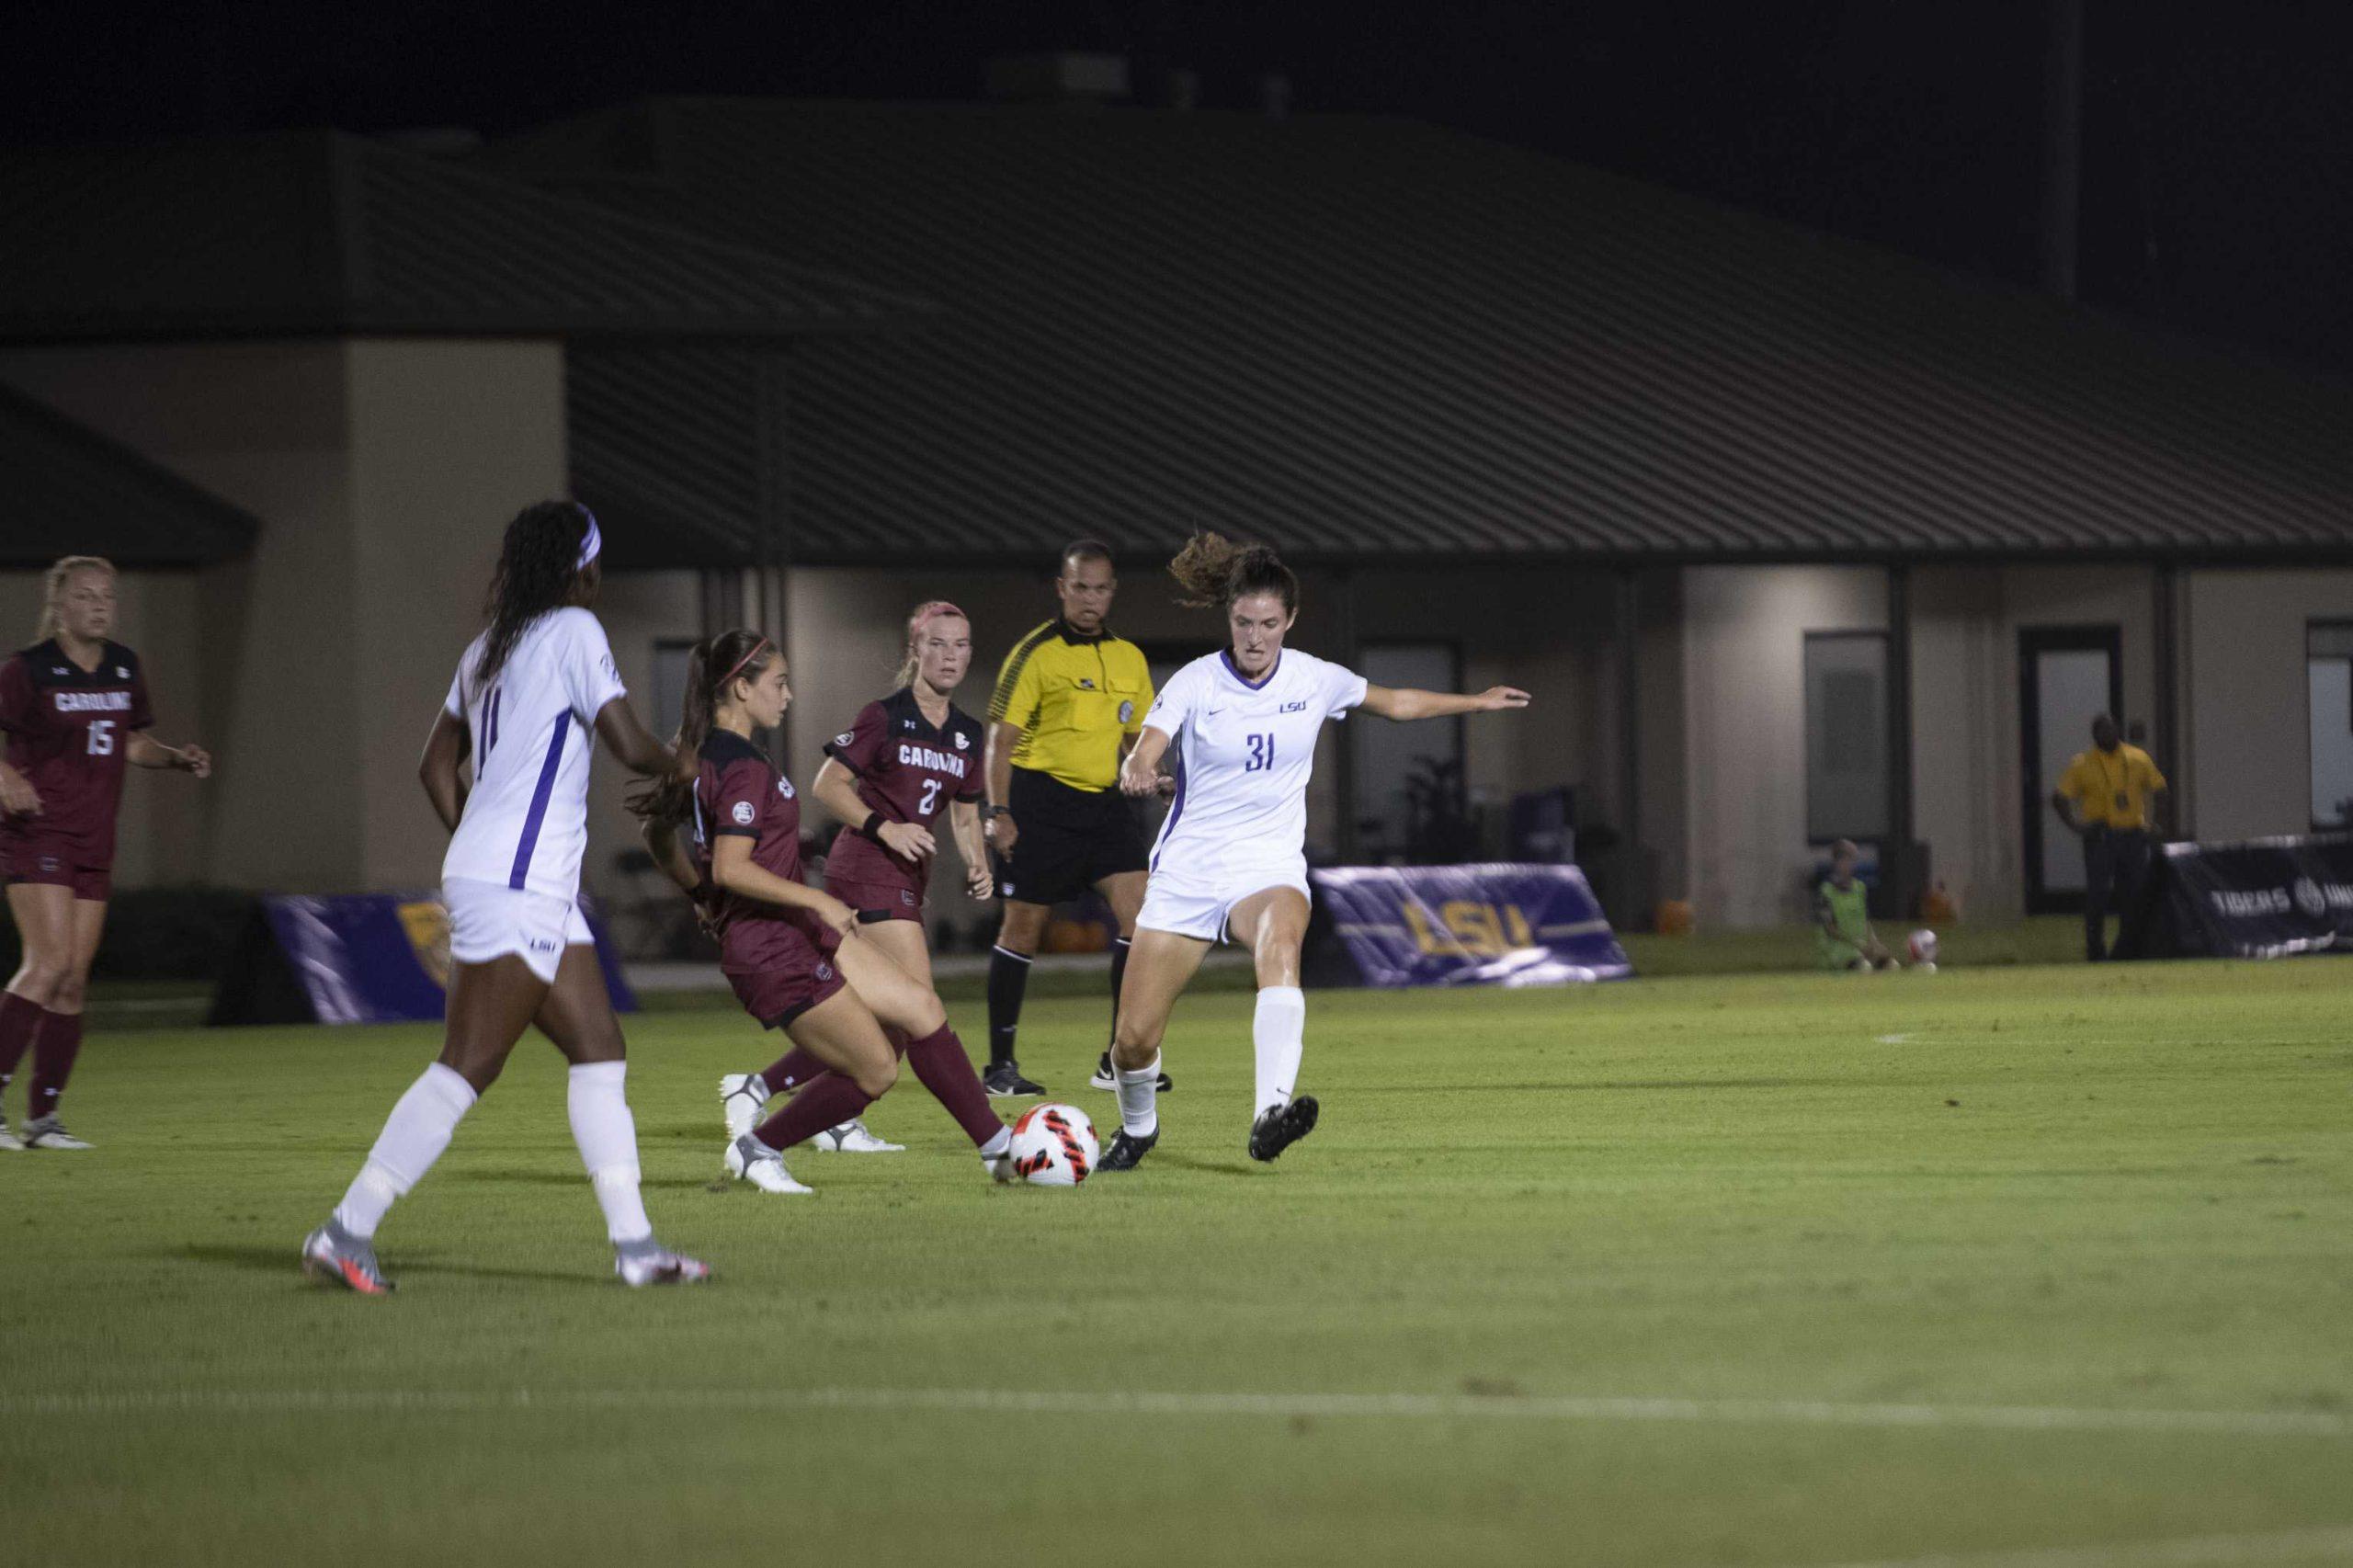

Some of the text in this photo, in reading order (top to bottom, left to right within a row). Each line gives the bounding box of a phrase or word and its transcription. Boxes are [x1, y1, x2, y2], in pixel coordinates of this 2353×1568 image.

[1279, 700, 1306, 713] LSU
[86, 721, 116, 756] 15
[1245, 733, 1274, 772] 31
[2211, 887, 2291, 916] TIGERS
[1404, 901, 1533, 954] LSU
